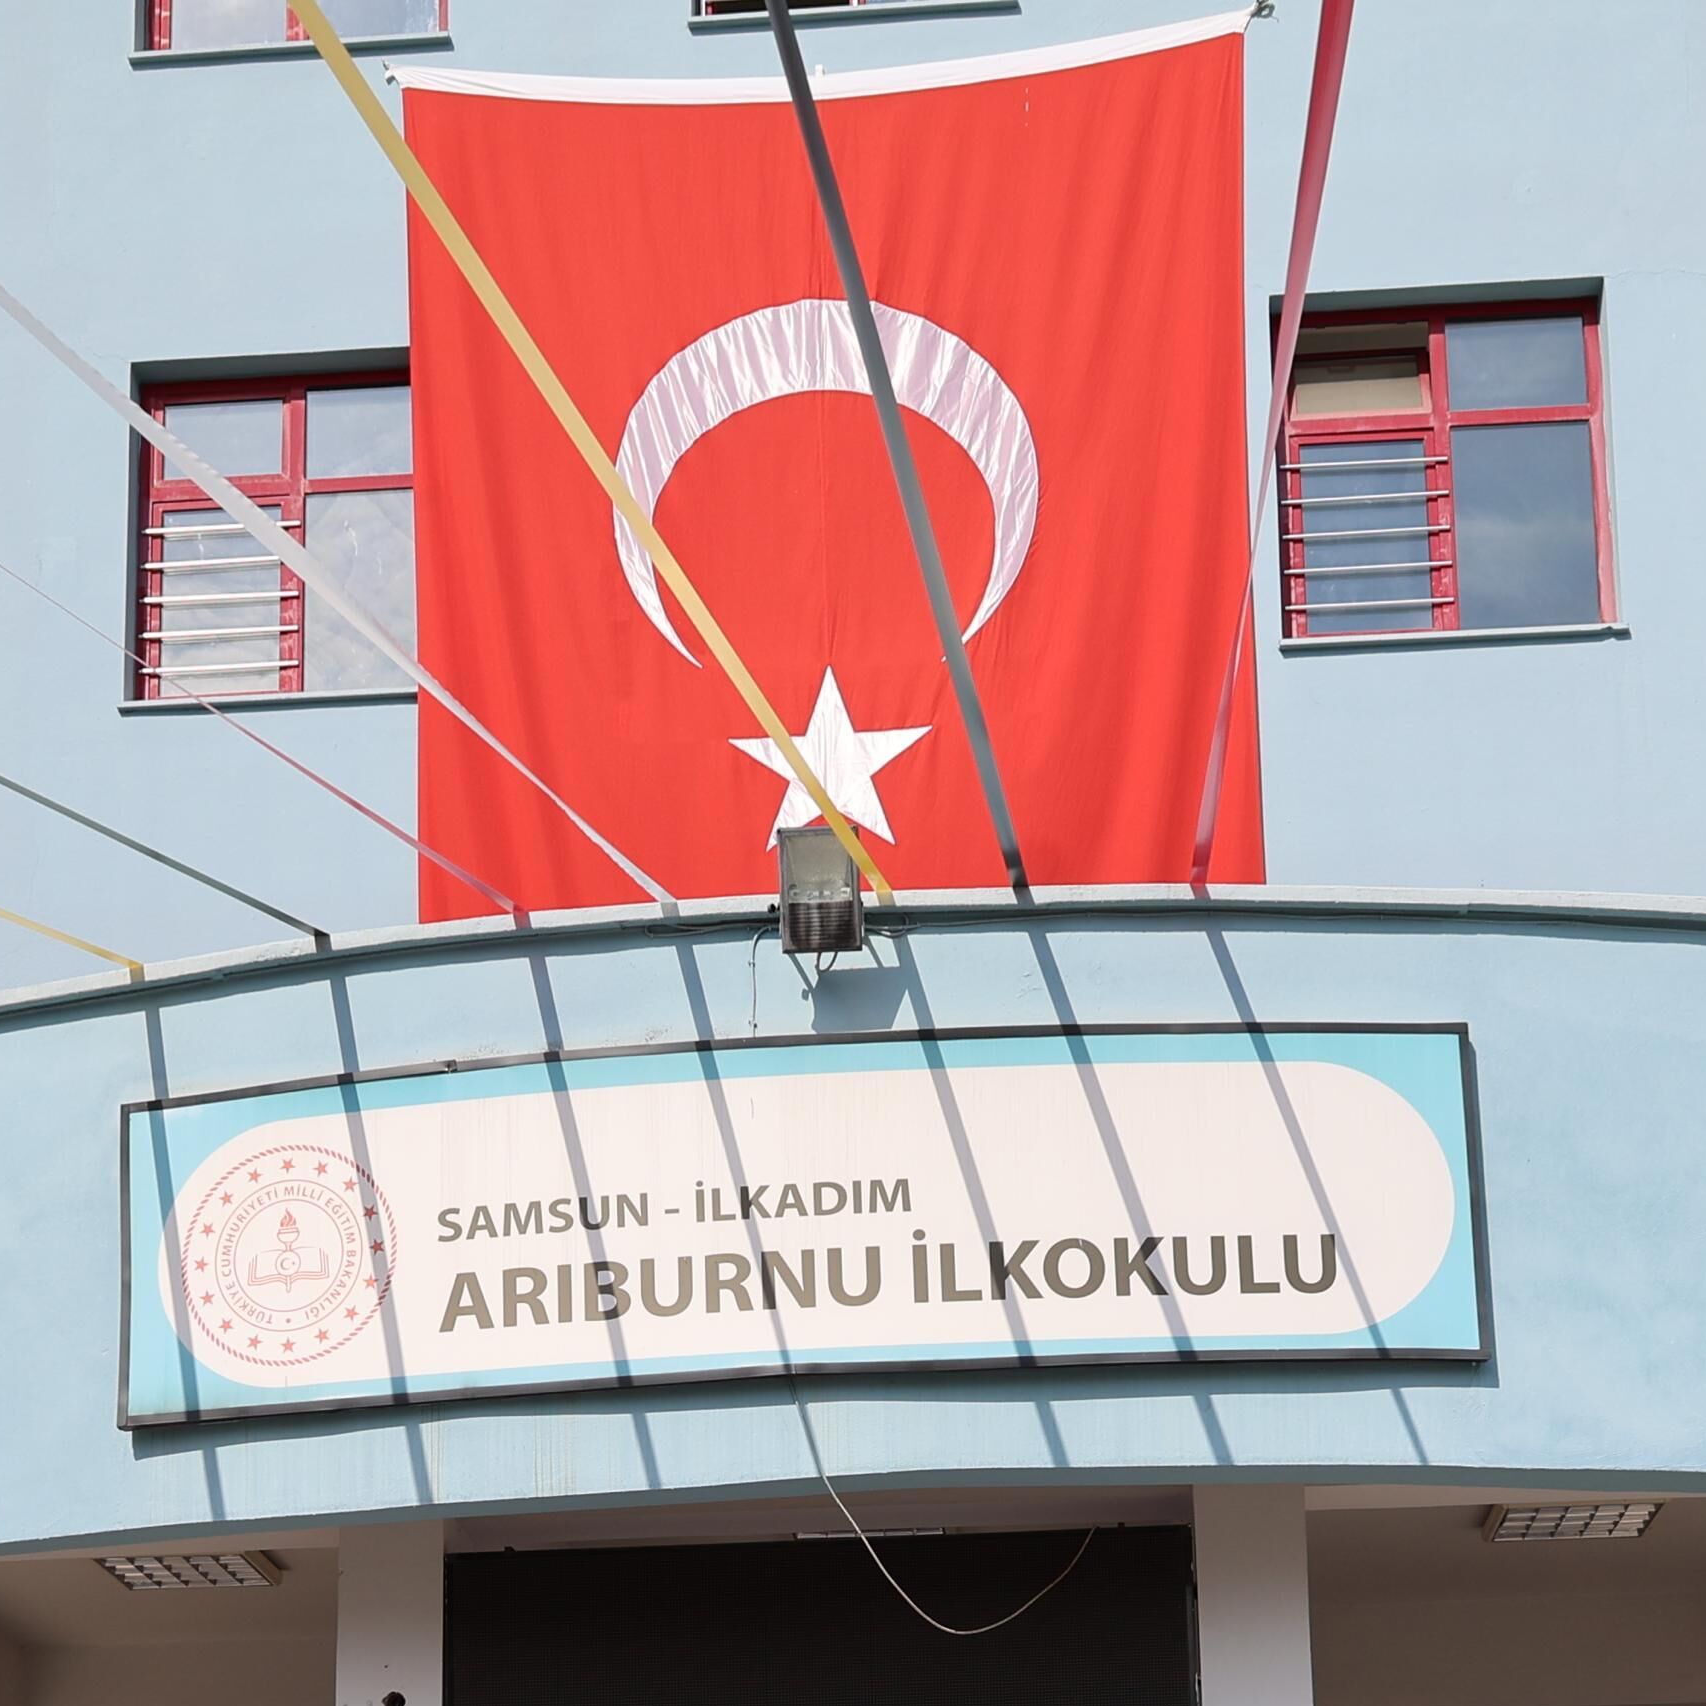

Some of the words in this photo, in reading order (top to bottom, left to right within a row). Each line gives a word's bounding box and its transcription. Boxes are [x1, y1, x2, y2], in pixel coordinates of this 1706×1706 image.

[283, 1183, 325, 1202] MİLLİ
[324, 1196, 357, 1244] EĞİTİM
[437, 1191, 649, 1243] SAMSUN
[694, 1178, 912, 1223] İLKADIM
[220, 1189, 279, 1278] CUMHURİYETİ
[225, 1281, 274, 1325] TÜRKİYE
[304, 1249, 357, 1321] BAKANLIĞI
[438, 1245, 882, 1333] ARIBURNU
[911, 1228, 1337, 1304] İLKOKULU
